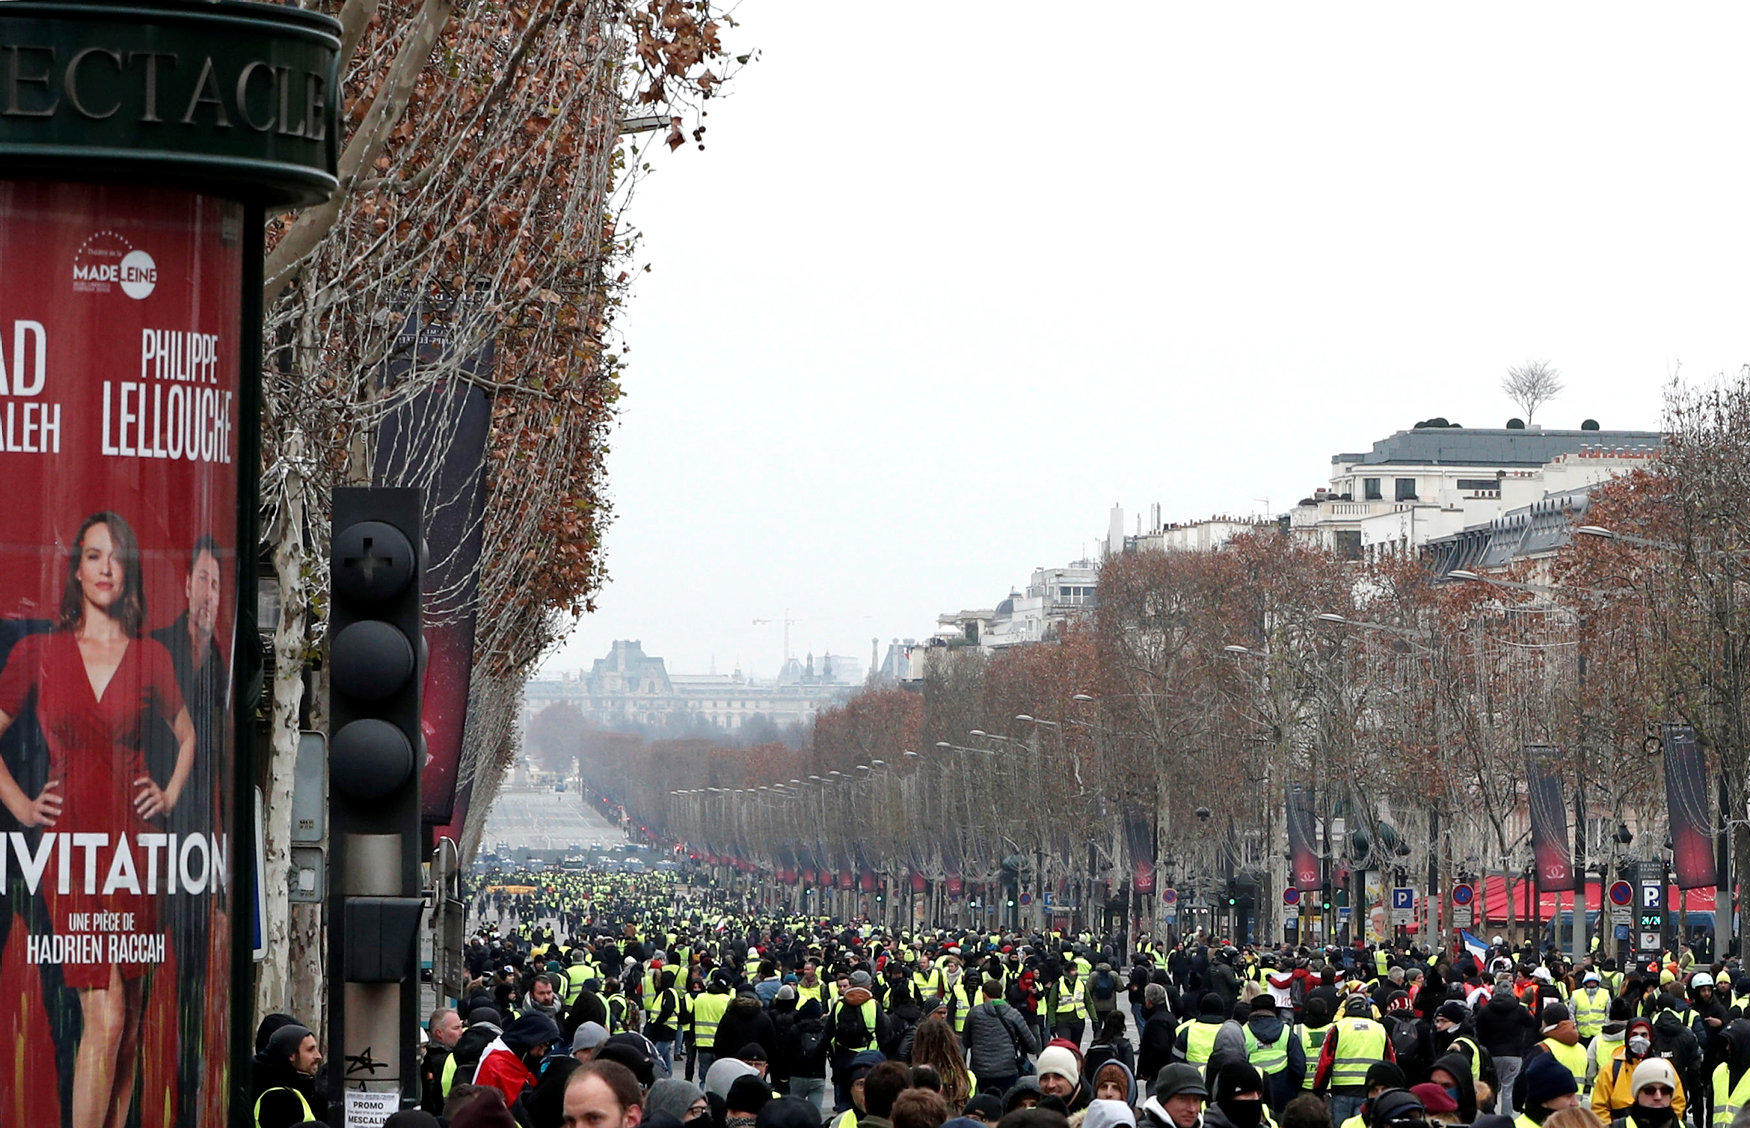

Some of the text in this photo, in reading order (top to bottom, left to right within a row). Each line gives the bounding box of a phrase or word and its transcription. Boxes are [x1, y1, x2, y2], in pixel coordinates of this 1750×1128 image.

[73, 264, 157, 284] MADELEINE
[0, 320, 47, 396] D
[141, 328, 218, 384] PHILIPPE
[0, 402, 61, 453] LEH
[102, 380, 232, 464] LELLOUCHE
[1398, 892, 1408, 906] P
[1643, 887, 1659, 907] P
[69, 909, 135, 931] UNE PIÈCE DE
[26, 934, 165, 964] HADRIEN RACCAH
[353, 1101, 384, 1110] PROMO
